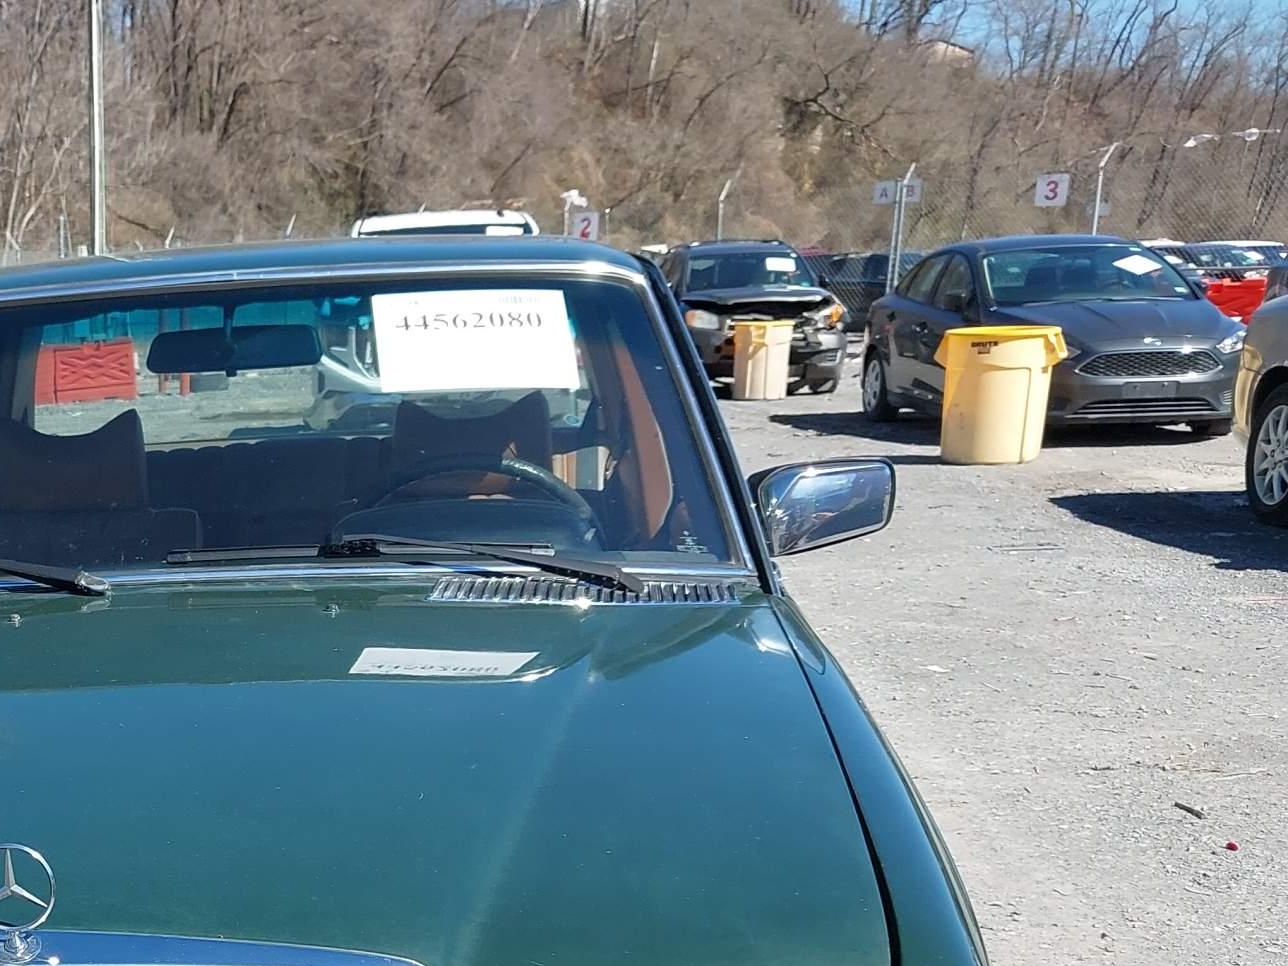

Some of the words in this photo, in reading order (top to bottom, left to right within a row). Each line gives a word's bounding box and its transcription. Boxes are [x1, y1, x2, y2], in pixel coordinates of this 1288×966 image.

[879, 186, 889, 199] A
[1044, 180, 1059, 201] 3
[579, 217, 592, 240] 2
[395, 311, 543, 331] 44562080
